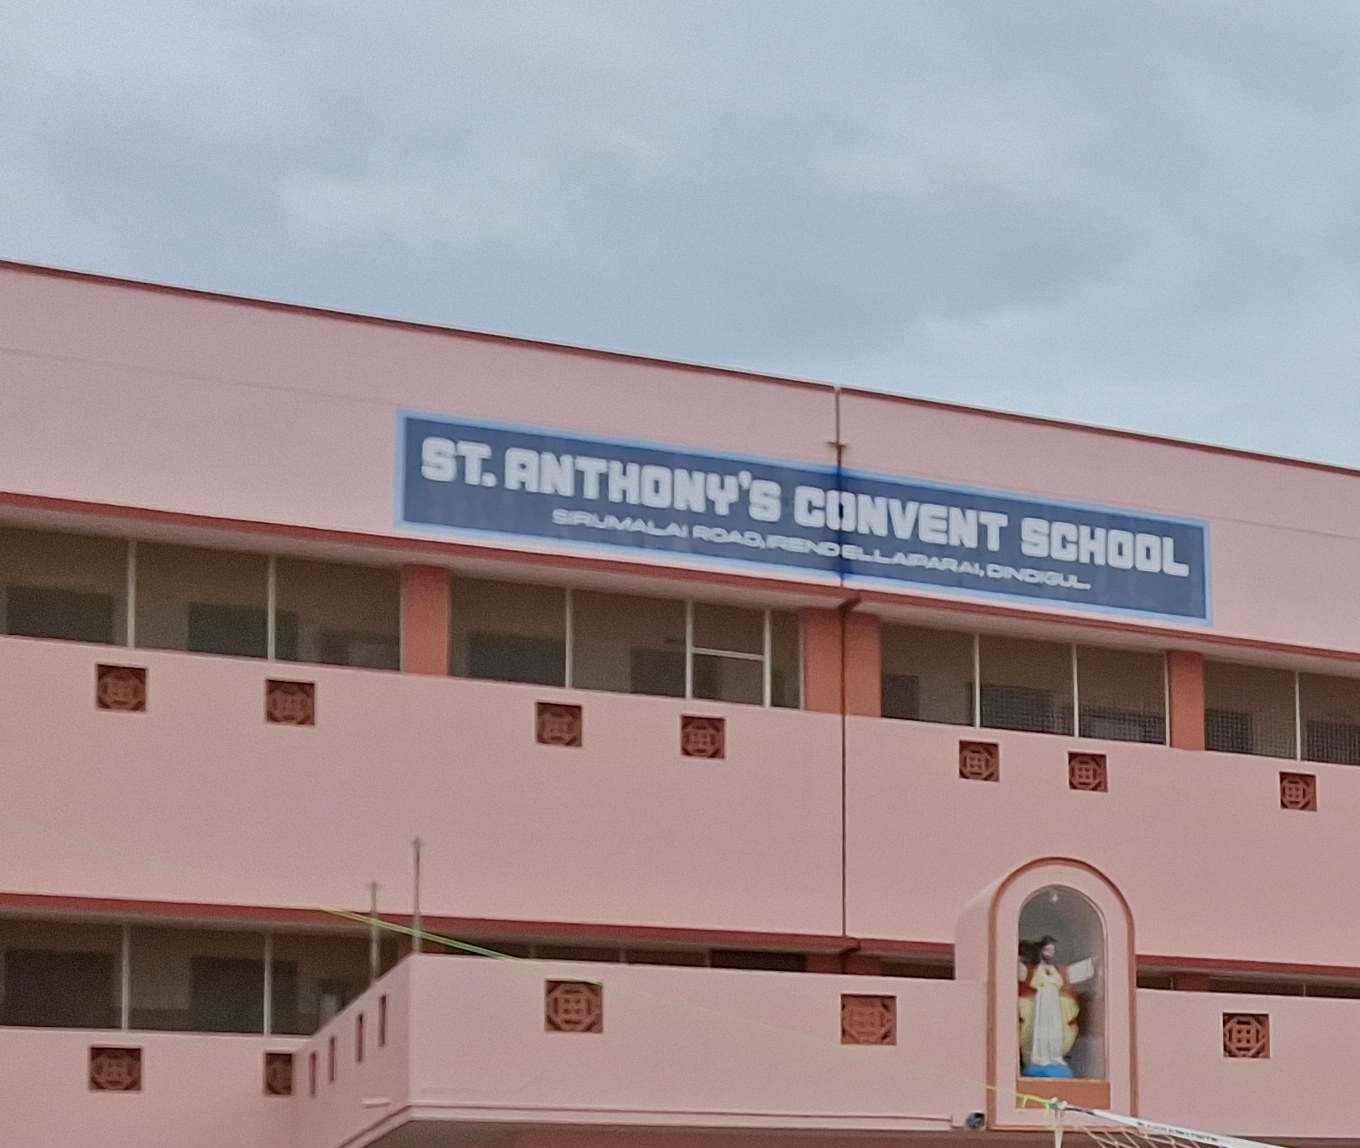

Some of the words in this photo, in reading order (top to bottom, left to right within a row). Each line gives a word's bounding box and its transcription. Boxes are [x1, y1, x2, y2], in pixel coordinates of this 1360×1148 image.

[504, 447, 782, 522] ANTHONY'S
[793, 486, 1008, 551] CONVENT
[1021, 518, 1190, 577] SCHOOL
[552, 509, 689, 538] SIRUMALAI
